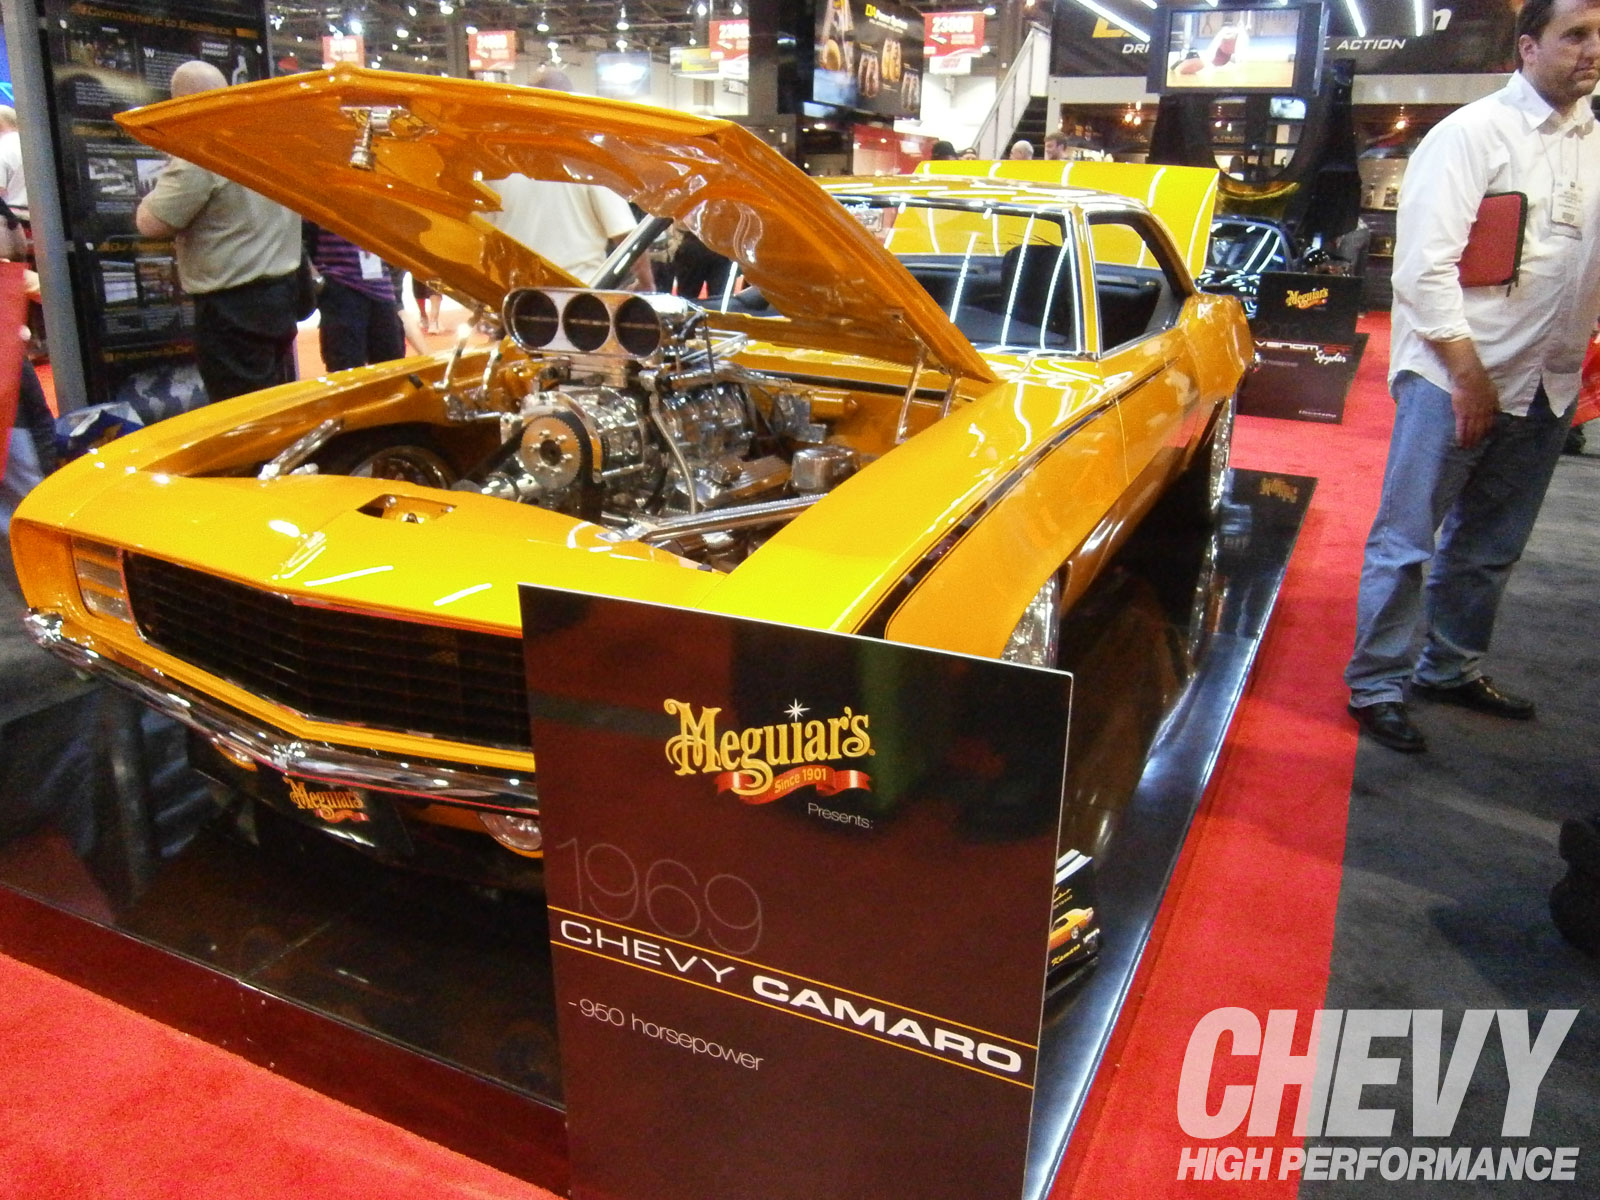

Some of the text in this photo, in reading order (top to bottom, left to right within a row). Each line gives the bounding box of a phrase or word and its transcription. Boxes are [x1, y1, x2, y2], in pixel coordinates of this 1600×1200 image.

[1336, 38, 1407, 51] ACTION
[1314, 350, 1347, 365] Spyder
[663, 697, 872, 796] Meguiar's
[774, 767, 827, 794] Since 1901
[807, 802, 874, 829] Presents:
[555, 837, 762, 954] 1969
[560, 919, 1022, 1073] CHEVY CAMARO
[631, 1012, 765, 1071] horsepower
